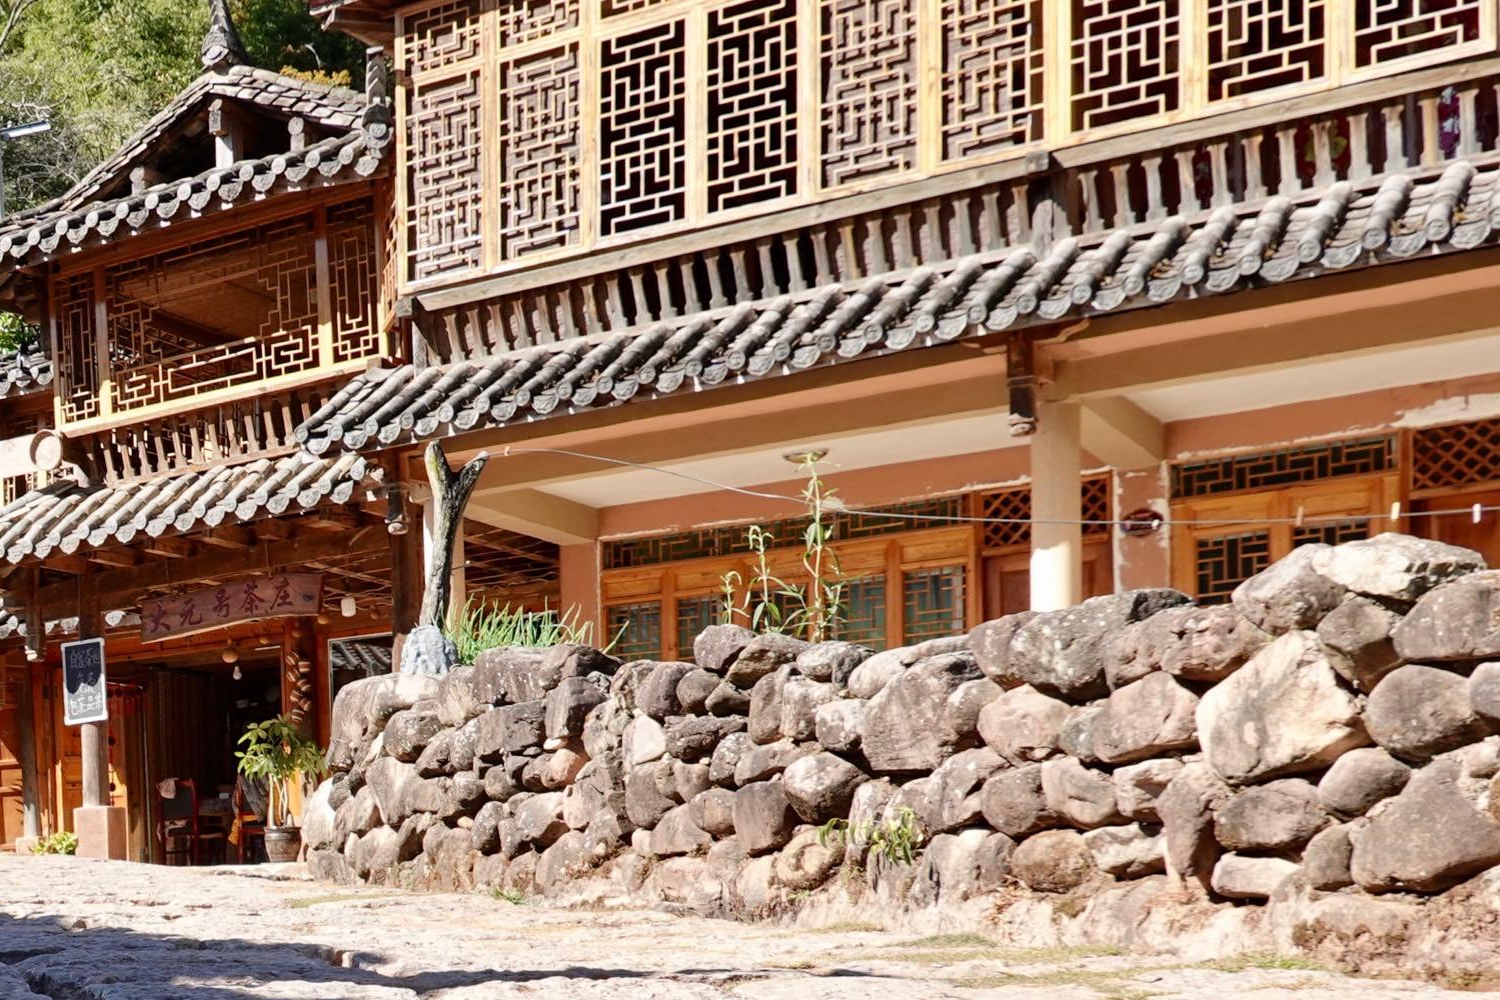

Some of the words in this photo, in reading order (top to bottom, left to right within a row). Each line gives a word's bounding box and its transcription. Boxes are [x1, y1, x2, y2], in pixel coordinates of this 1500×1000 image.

[150, 575, 293, 633] 大元号茶庄
